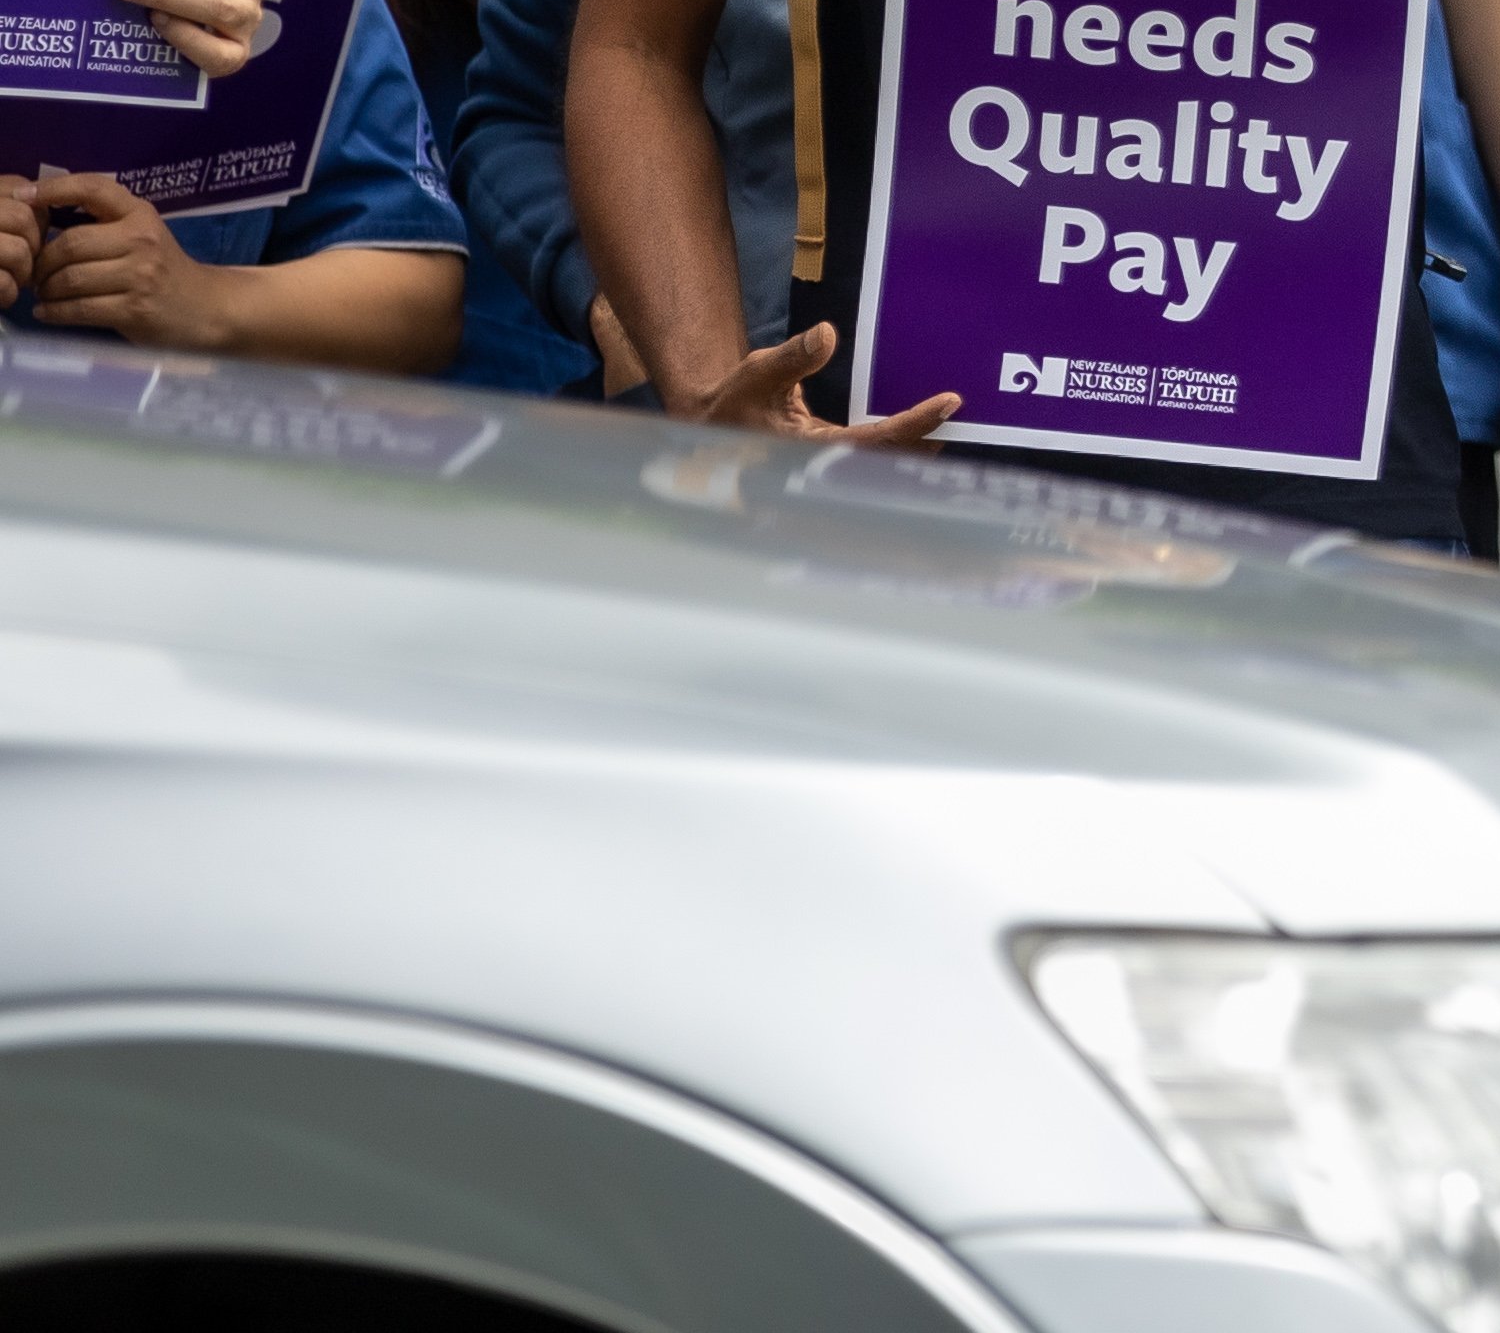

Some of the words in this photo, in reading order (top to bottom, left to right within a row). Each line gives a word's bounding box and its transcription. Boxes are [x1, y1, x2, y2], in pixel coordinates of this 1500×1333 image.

[0, 15, 18, 30] EW
[20, 17, 76, 32] ZEALAND
[92, 18, 161, 39] TŌPŪTAN
[0, 54, 71, 69] GANISATION
[132, 65, 180, 77] AOTEAROA
[947, 85, 1350, 222] Quality
[213, 154, 292, 180] TAPUHI
[1036, 206, 1238, 323] Pay
[1070, 360, 1096, 371] NEW
[1097, 362, 1148, 376] ZEALAND
[1161, 367, 1238, 386] TŌPŪTANGA
[1068, 372, 1147, 393] NURSES
[1066, 389, 1145, 405] ORGANISATION
[1158, 382, 1237, 404] TAPUHI
